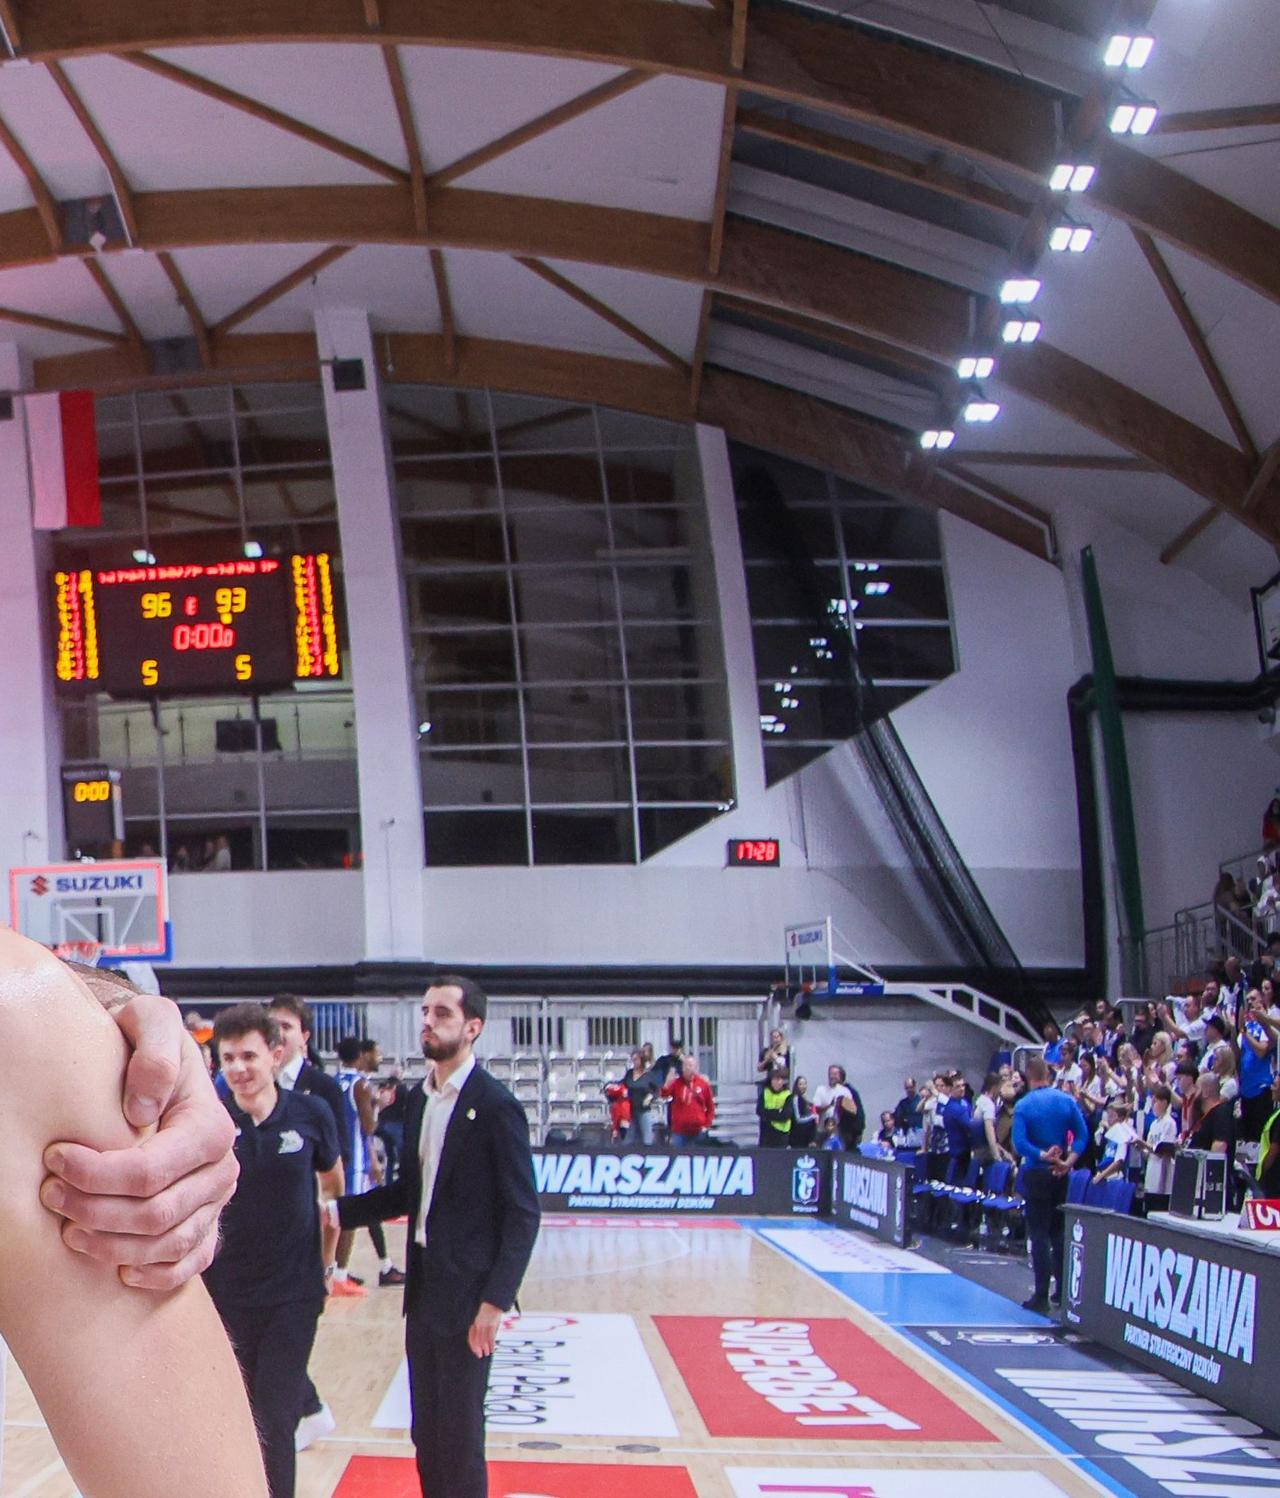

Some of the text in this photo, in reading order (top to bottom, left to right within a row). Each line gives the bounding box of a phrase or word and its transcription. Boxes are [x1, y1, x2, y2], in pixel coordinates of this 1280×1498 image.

[142, 592, 171, 618] 96
[215, 588, 246, 613] 93
[56, 875, 143, 893] SUZUKI
[532, 1154, 754, 1195] WARSZAWA
[1105, 1233, 1257, 1365] WARSZAWA
[720, 1319, 922, 1430] SUPERBET
[483, 1374, 575, 1425] Pekao
